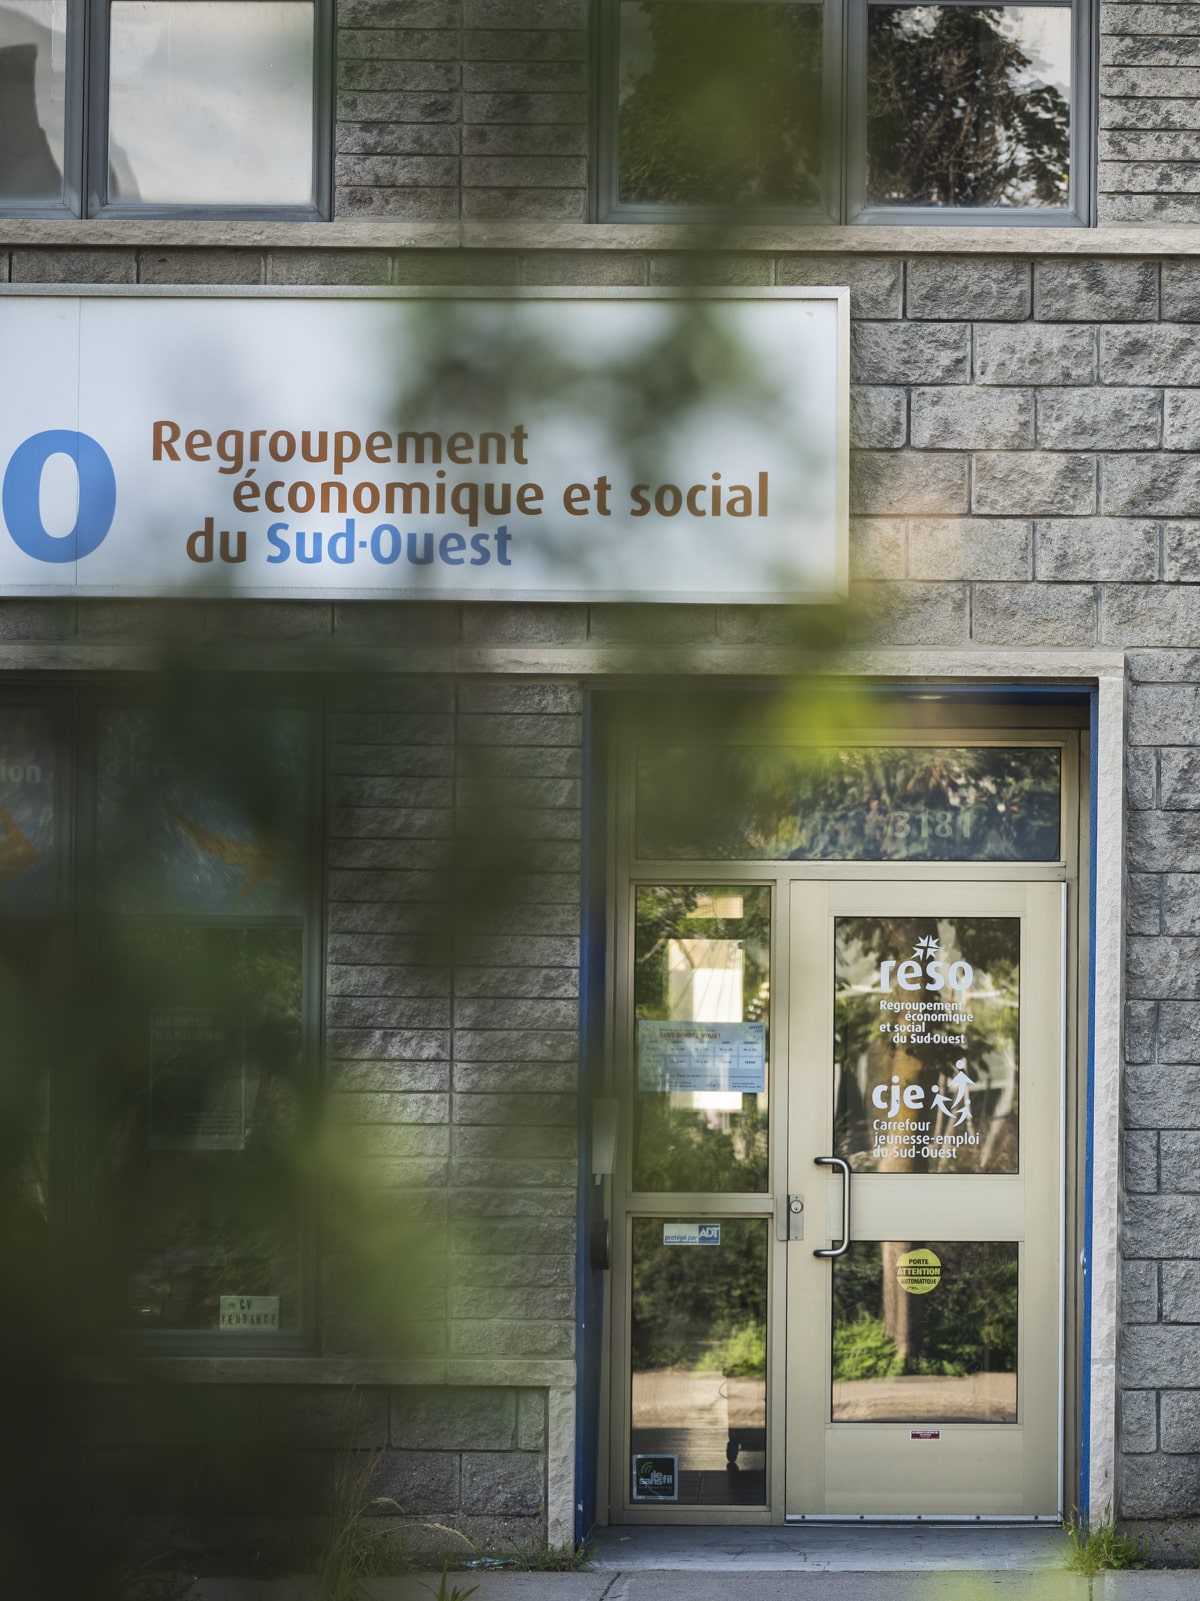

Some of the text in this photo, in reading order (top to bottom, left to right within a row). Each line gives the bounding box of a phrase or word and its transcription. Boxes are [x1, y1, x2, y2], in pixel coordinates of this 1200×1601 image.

[152, 420, 529, 475] Regroupement
[233, 469, 769, 528] économique et social
[186, 517, 248, 565] du
[893, 811, 970, 838] 3181
[880, 1000, 963, 1014] Regroupement
[905, 1010, 974, 1024] économique
[880, 1022, 926, 1033] et social
[892, 1033, 907, 1044] du
[872, 1075, 925, 1118] cje
[873, 1118, 931, 1131] Carrefour
[874, 1132, 980, 1147] jeunesse-emploi
[873, 1146, 957, 1158] du Sud-Ouest
[699, 1227, 719, 1238] ADT
